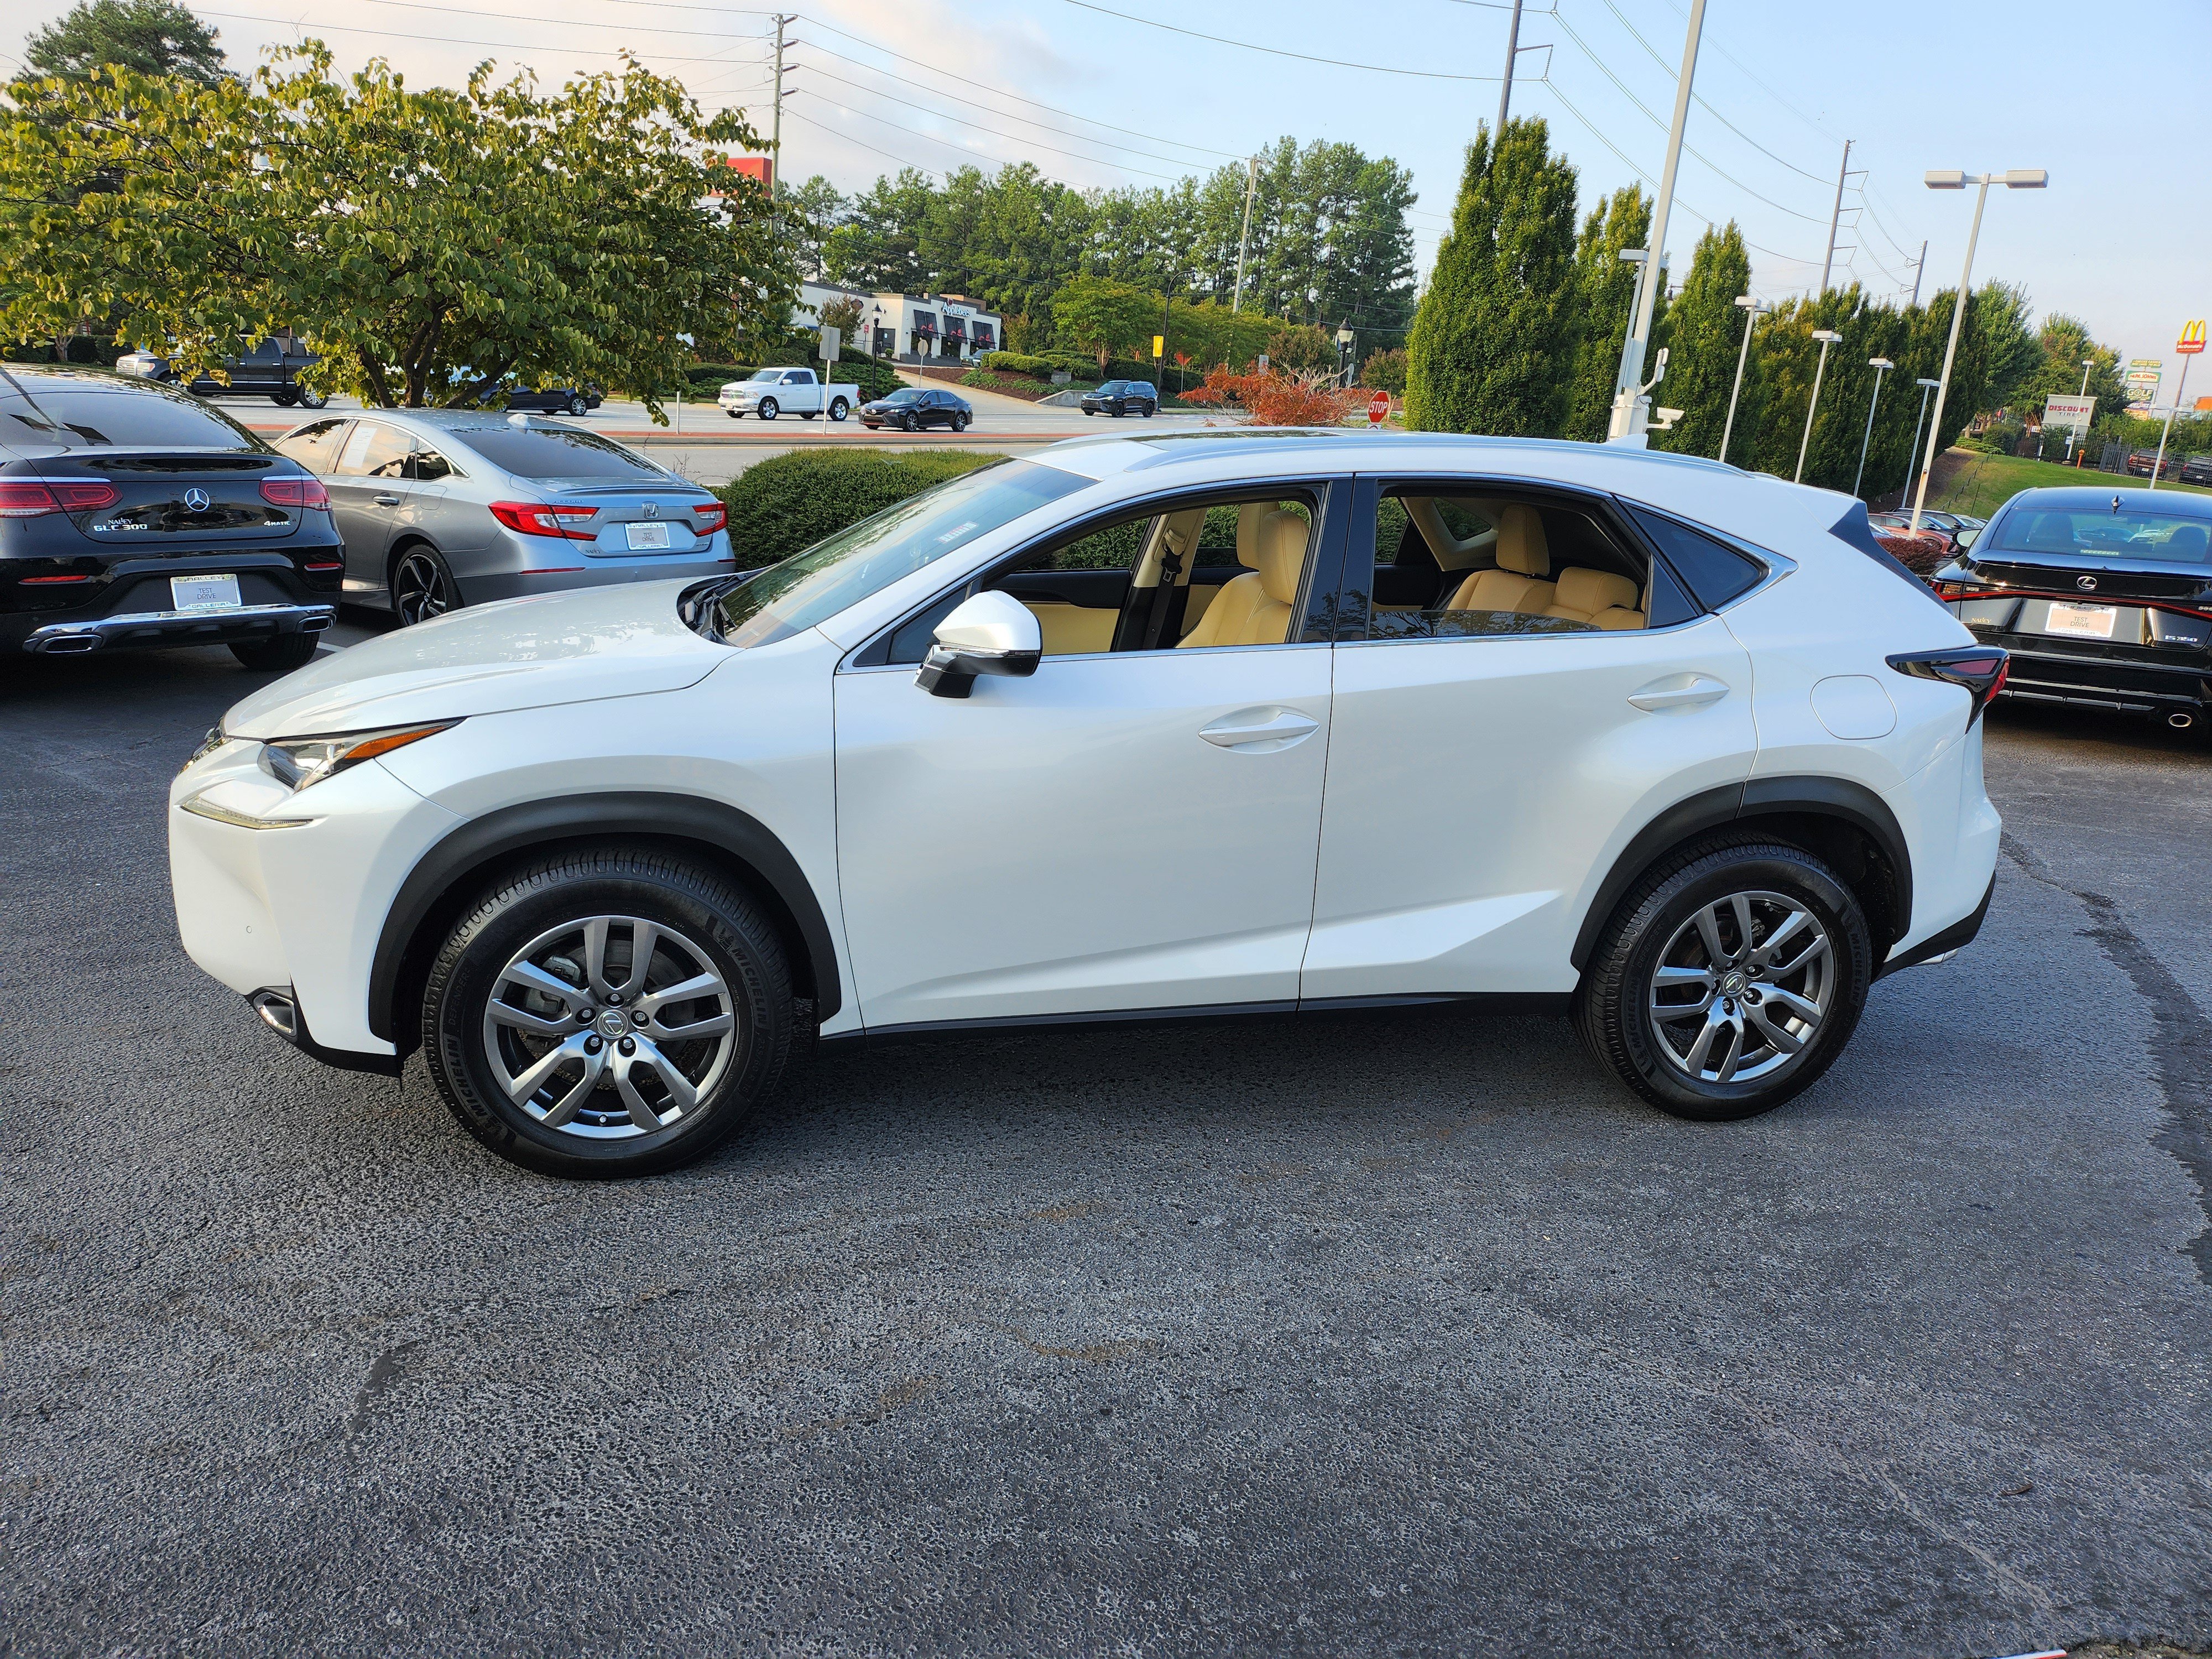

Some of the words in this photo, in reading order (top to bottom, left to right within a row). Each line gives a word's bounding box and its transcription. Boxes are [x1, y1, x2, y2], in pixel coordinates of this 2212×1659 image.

[1369, 401, 1388, 413] STOP
[732, 947, 767, 1025] MICHELIN
[1850, 933, 1863, 1002] MICHELIN
[1627, 978, 1642, 1048] MICHELIN
[447, 1038, 489, 1118] MICHELIN
